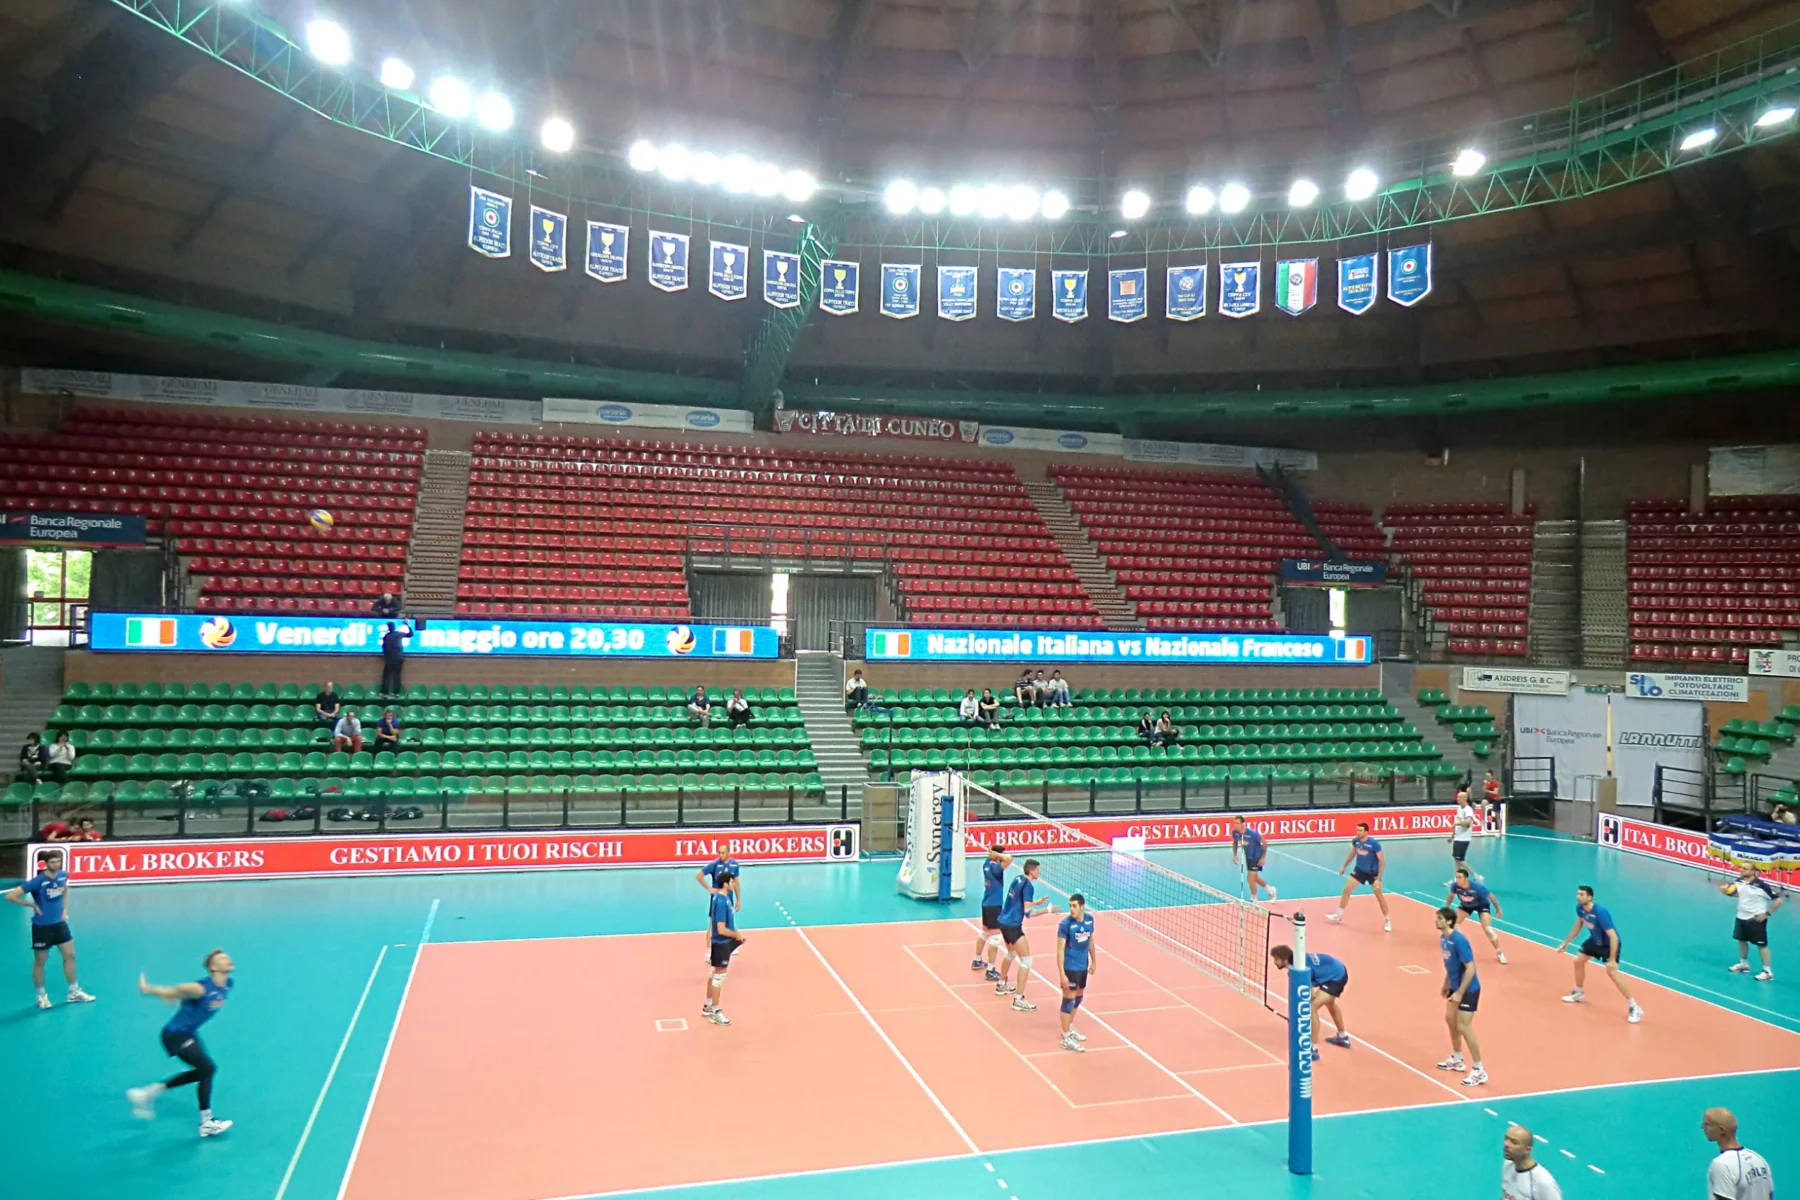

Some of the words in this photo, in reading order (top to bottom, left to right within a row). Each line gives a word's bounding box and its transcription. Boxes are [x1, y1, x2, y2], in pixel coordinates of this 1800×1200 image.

[30, 515, 66, 526] Banca
[67, 516, 122, 530] Regionale
[30, 527, 78, 539] Europea
[1297, 562, 1310, 570] UBI
[1323, 563, 1343, 571] Banca
[1343, 563, 1374, 574] Regionale
[1323, 572, 1350, 580] Europea
[420, 625, 517, 653] maggio
[522, 631, 564, 650] ore
[570, 627, 644, 652] 20,30
[927, 633, 1032, 656] Nazionale
[1037, 635, 1114, 656] Italiana
[1118, 639, 1141, 656] vs
[1145, 637, 1239, 657] Nazionale
[1242, 638, 1323, 657] Francese
[1494, 675, 1528, 683] ANDREIS
[1703, 676, 1743, 684] ELETTRICI
[1674, 682, 1734, 690] FOTOVOLTAICI
[1668, 689, 1739, 697] CLIMATIZZAZIONI
[1546, 728, 1568, 736] Banca
[1568, 730, 1602, 739] Regionale
[1546, 736, 1575, 744] Europea
[1127, 822, 1221, 840] GESTIAMO
[1243, 820, 1275, 836] UOI
[1279, 818, 1335, 835] RISCHI
[1373, 816, 1408, 831] ITAL
[1623, 827, 1662, 849] ITAL
[729, 836, 825, 855] BROKERS
[330, 844, 462, 865] GESTIAMO
[481, 843, 538, 860] TUOI
[544, 841, 623, 859] RISCHI
[74, 853, 136, 873] ITAL
[142, 849, 264, 871] BROKERS
